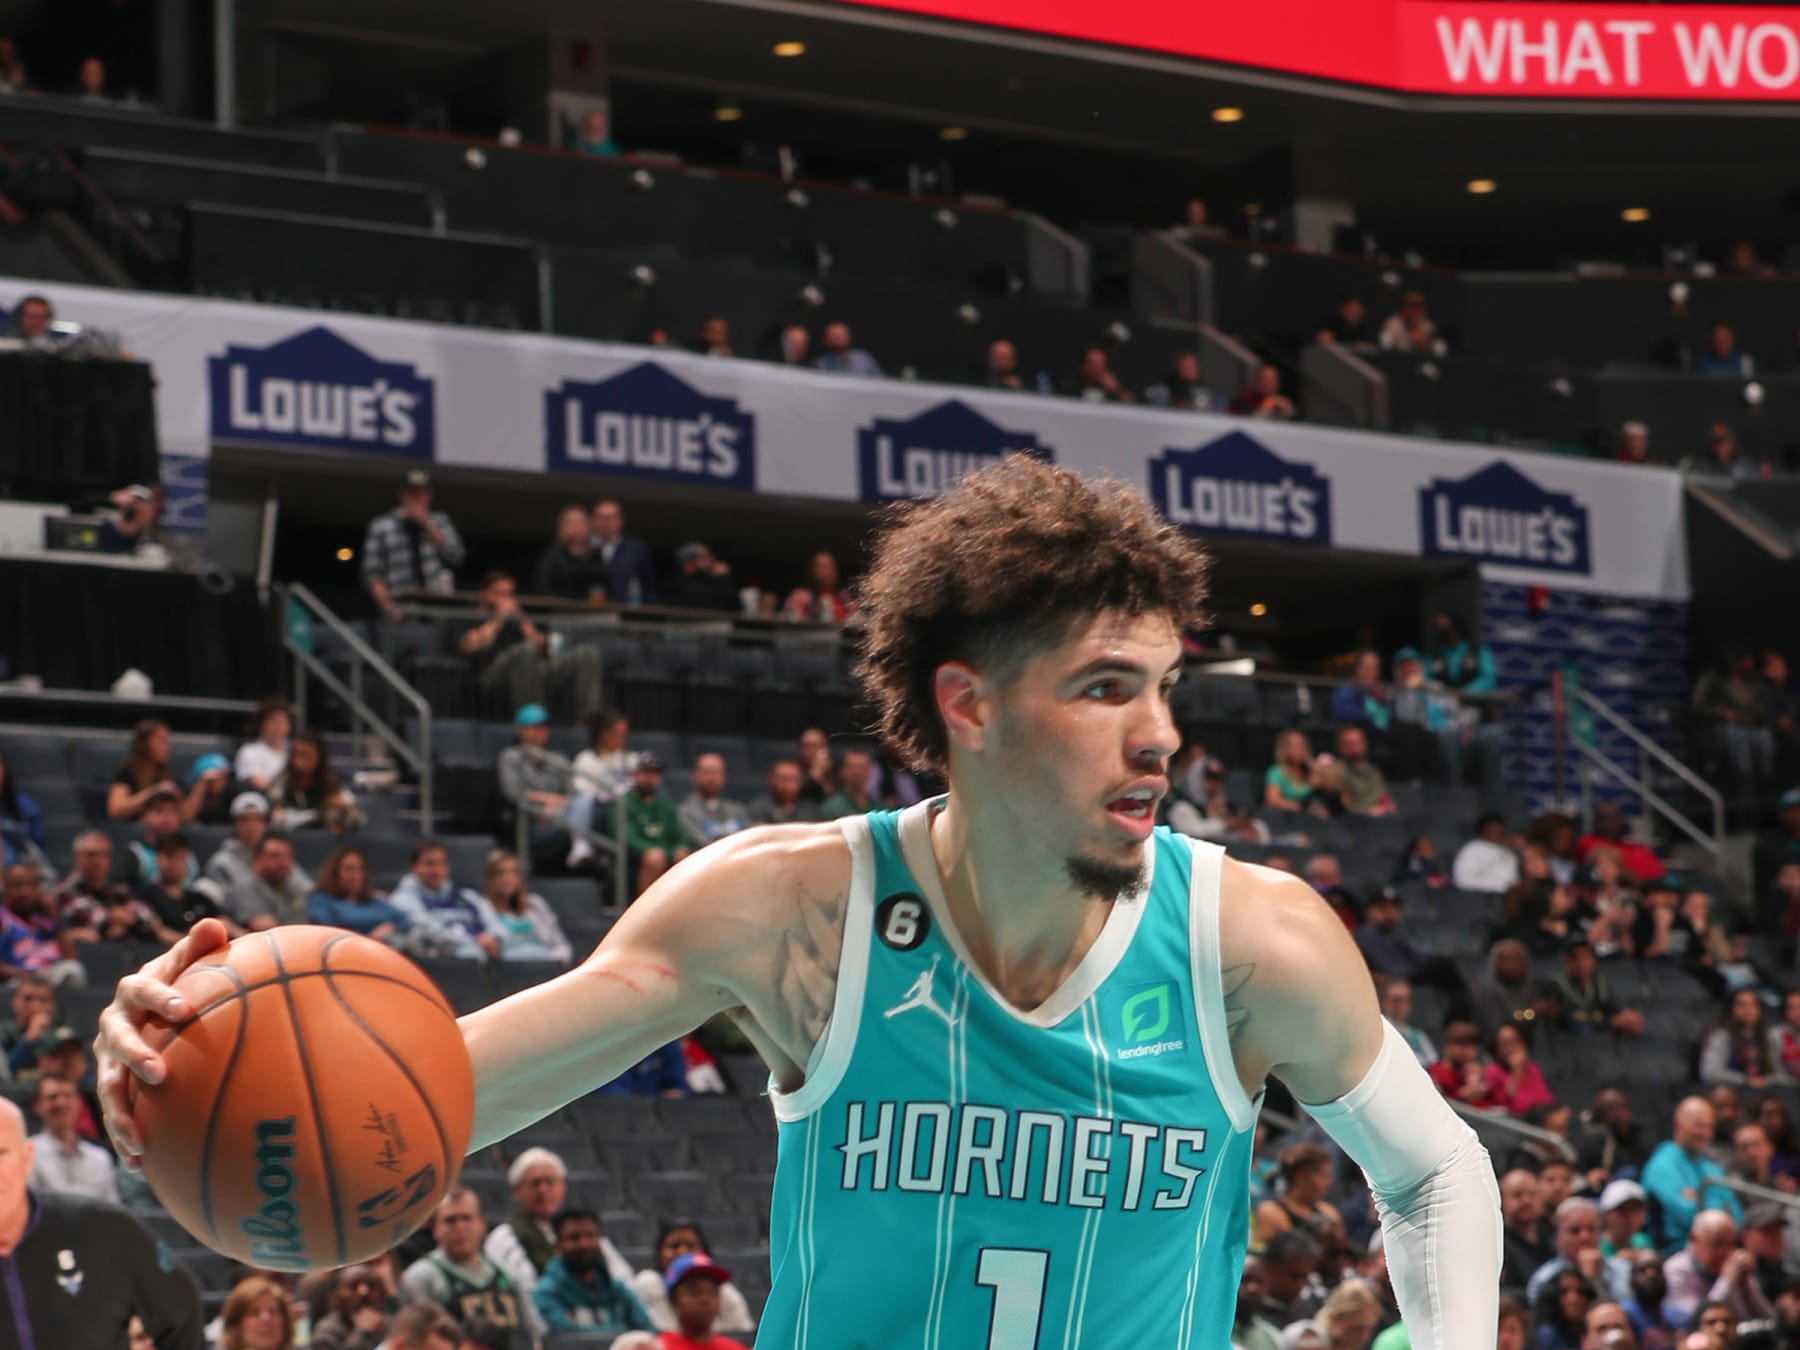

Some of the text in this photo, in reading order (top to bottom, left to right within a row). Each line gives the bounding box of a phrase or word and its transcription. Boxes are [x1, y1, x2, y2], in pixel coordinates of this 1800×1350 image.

[1436, 16, 1655, 86] WHAT
[230, 364, 418, 447] LOWE'S
[565, 398, 739, 478] LOWE'S
[1166, 464, 1317, 538] LOWE'S
[1434, 494, 1577, 565] LOWE'S
[886, 900, 921, 945] 6
[1117, 1040, 1184, 1059] lendingtree
[833, 1102, 1207, 1211] HORNETS
